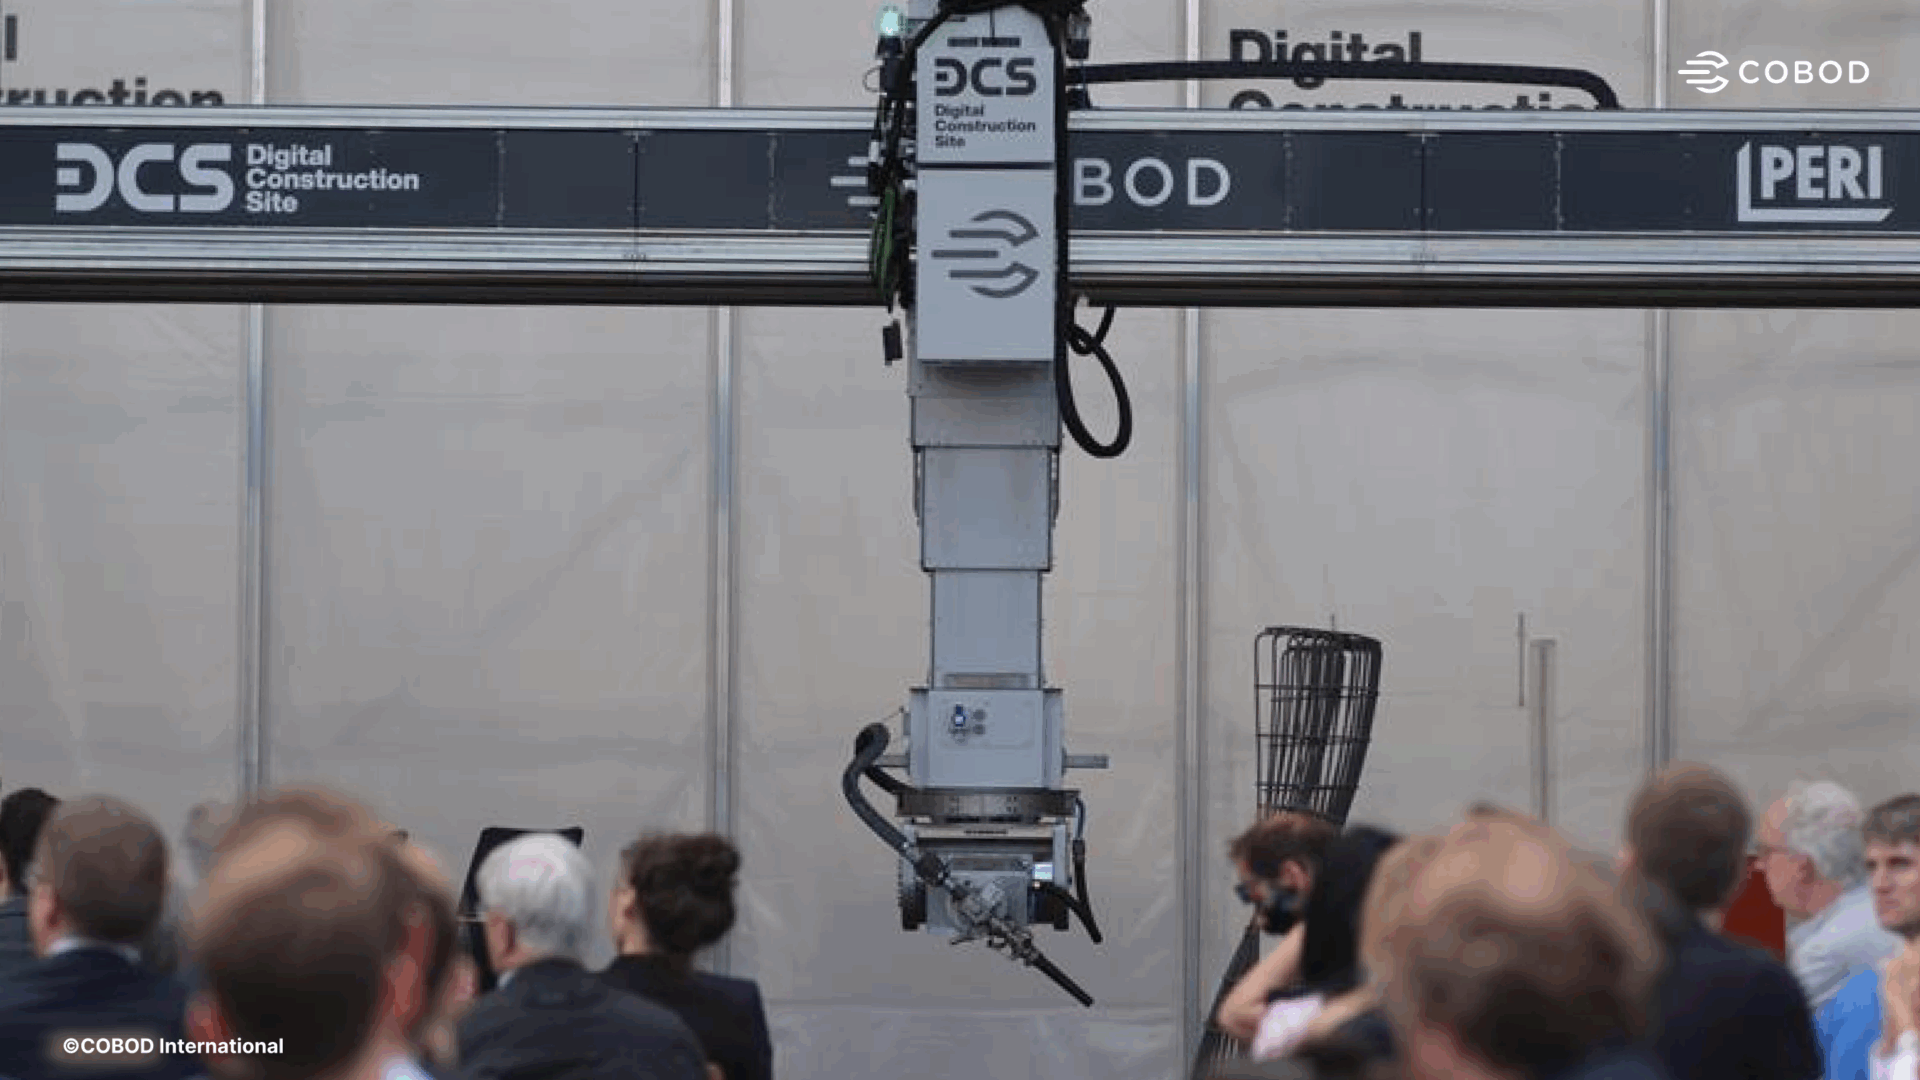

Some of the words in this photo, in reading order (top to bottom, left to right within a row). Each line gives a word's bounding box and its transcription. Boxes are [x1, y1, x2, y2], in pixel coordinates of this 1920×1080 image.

[1230, 28, 1422, 89] Digital
[935, 57, 1037, 96] DCS
[0, 77, 225, 106] ruction
[935, 104, 985, 119] Digital
[935, 118, 1036, 132] Construction
[935, 135, 966, 148] Site
[247, 144, 332, 170] Digital
[55, 143, 235, 213] DCS
[246, 168, 420, 190] Construction
[1073, 157, 1232, 207] BOD
[1760, 145, 1883, 200] PERI
[246, 190, 299, 213] Site
